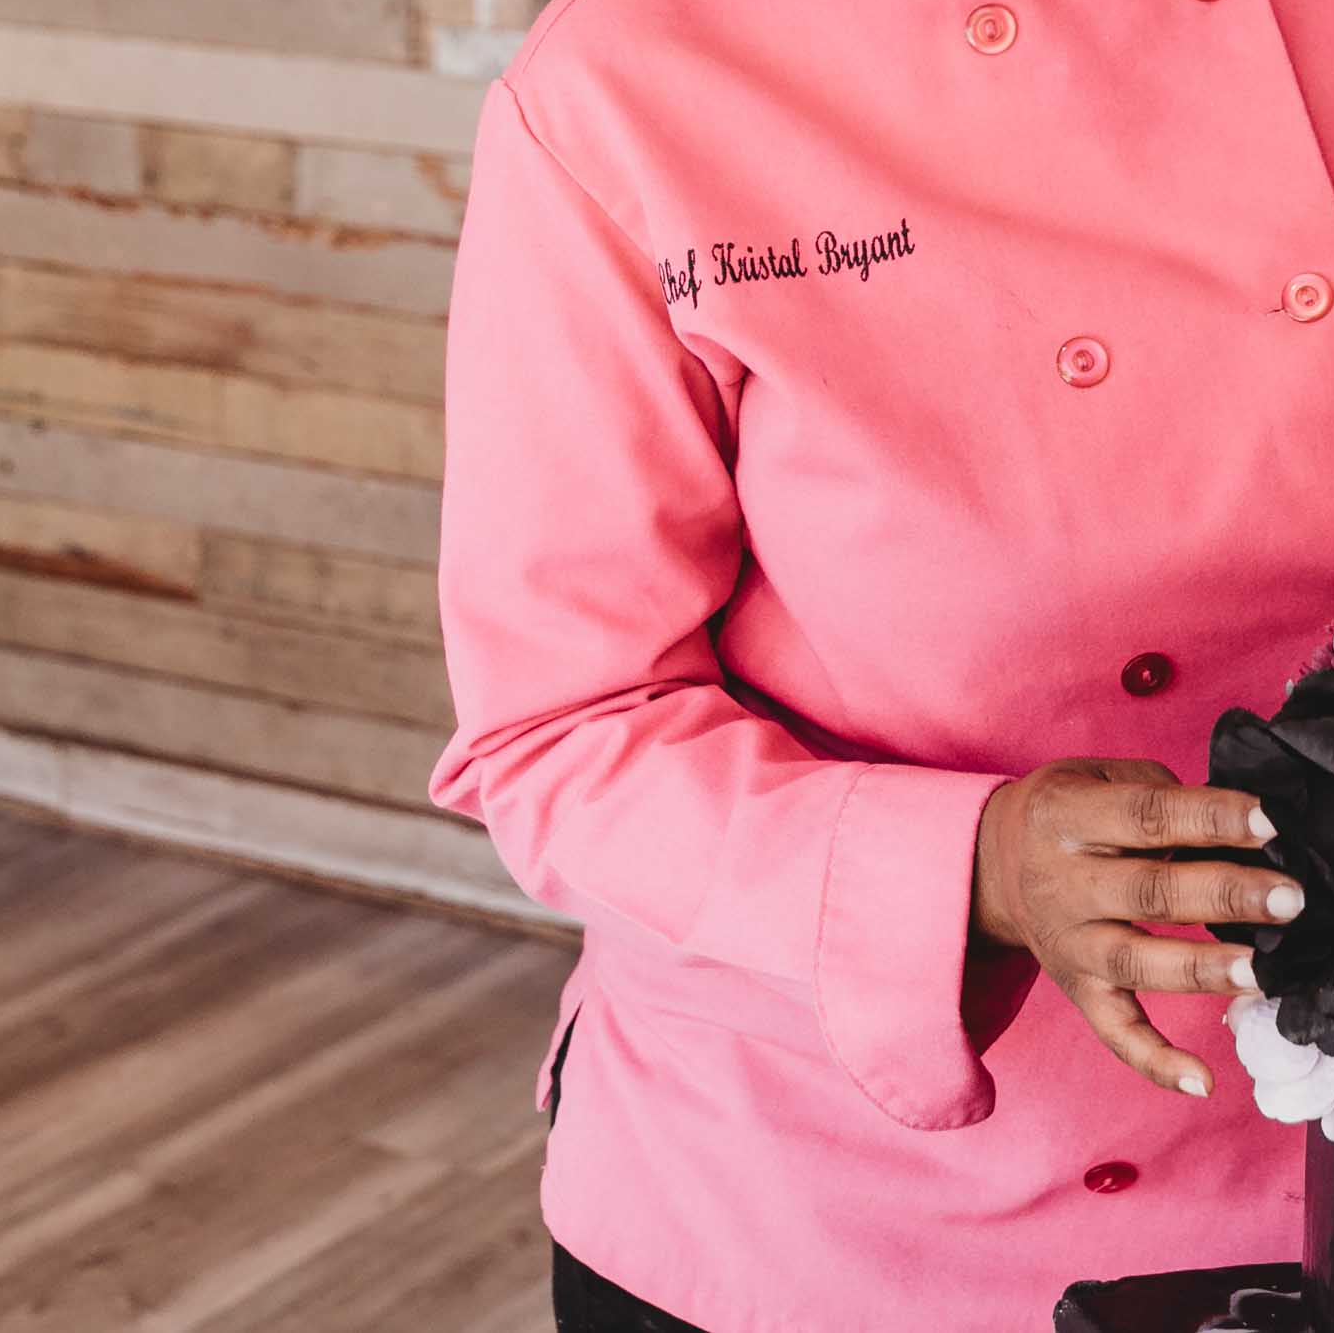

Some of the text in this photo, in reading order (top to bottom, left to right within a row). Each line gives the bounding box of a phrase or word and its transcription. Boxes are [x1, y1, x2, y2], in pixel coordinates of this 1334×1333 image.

[658, 218, 915, 310] Chef Kristal Bryant
